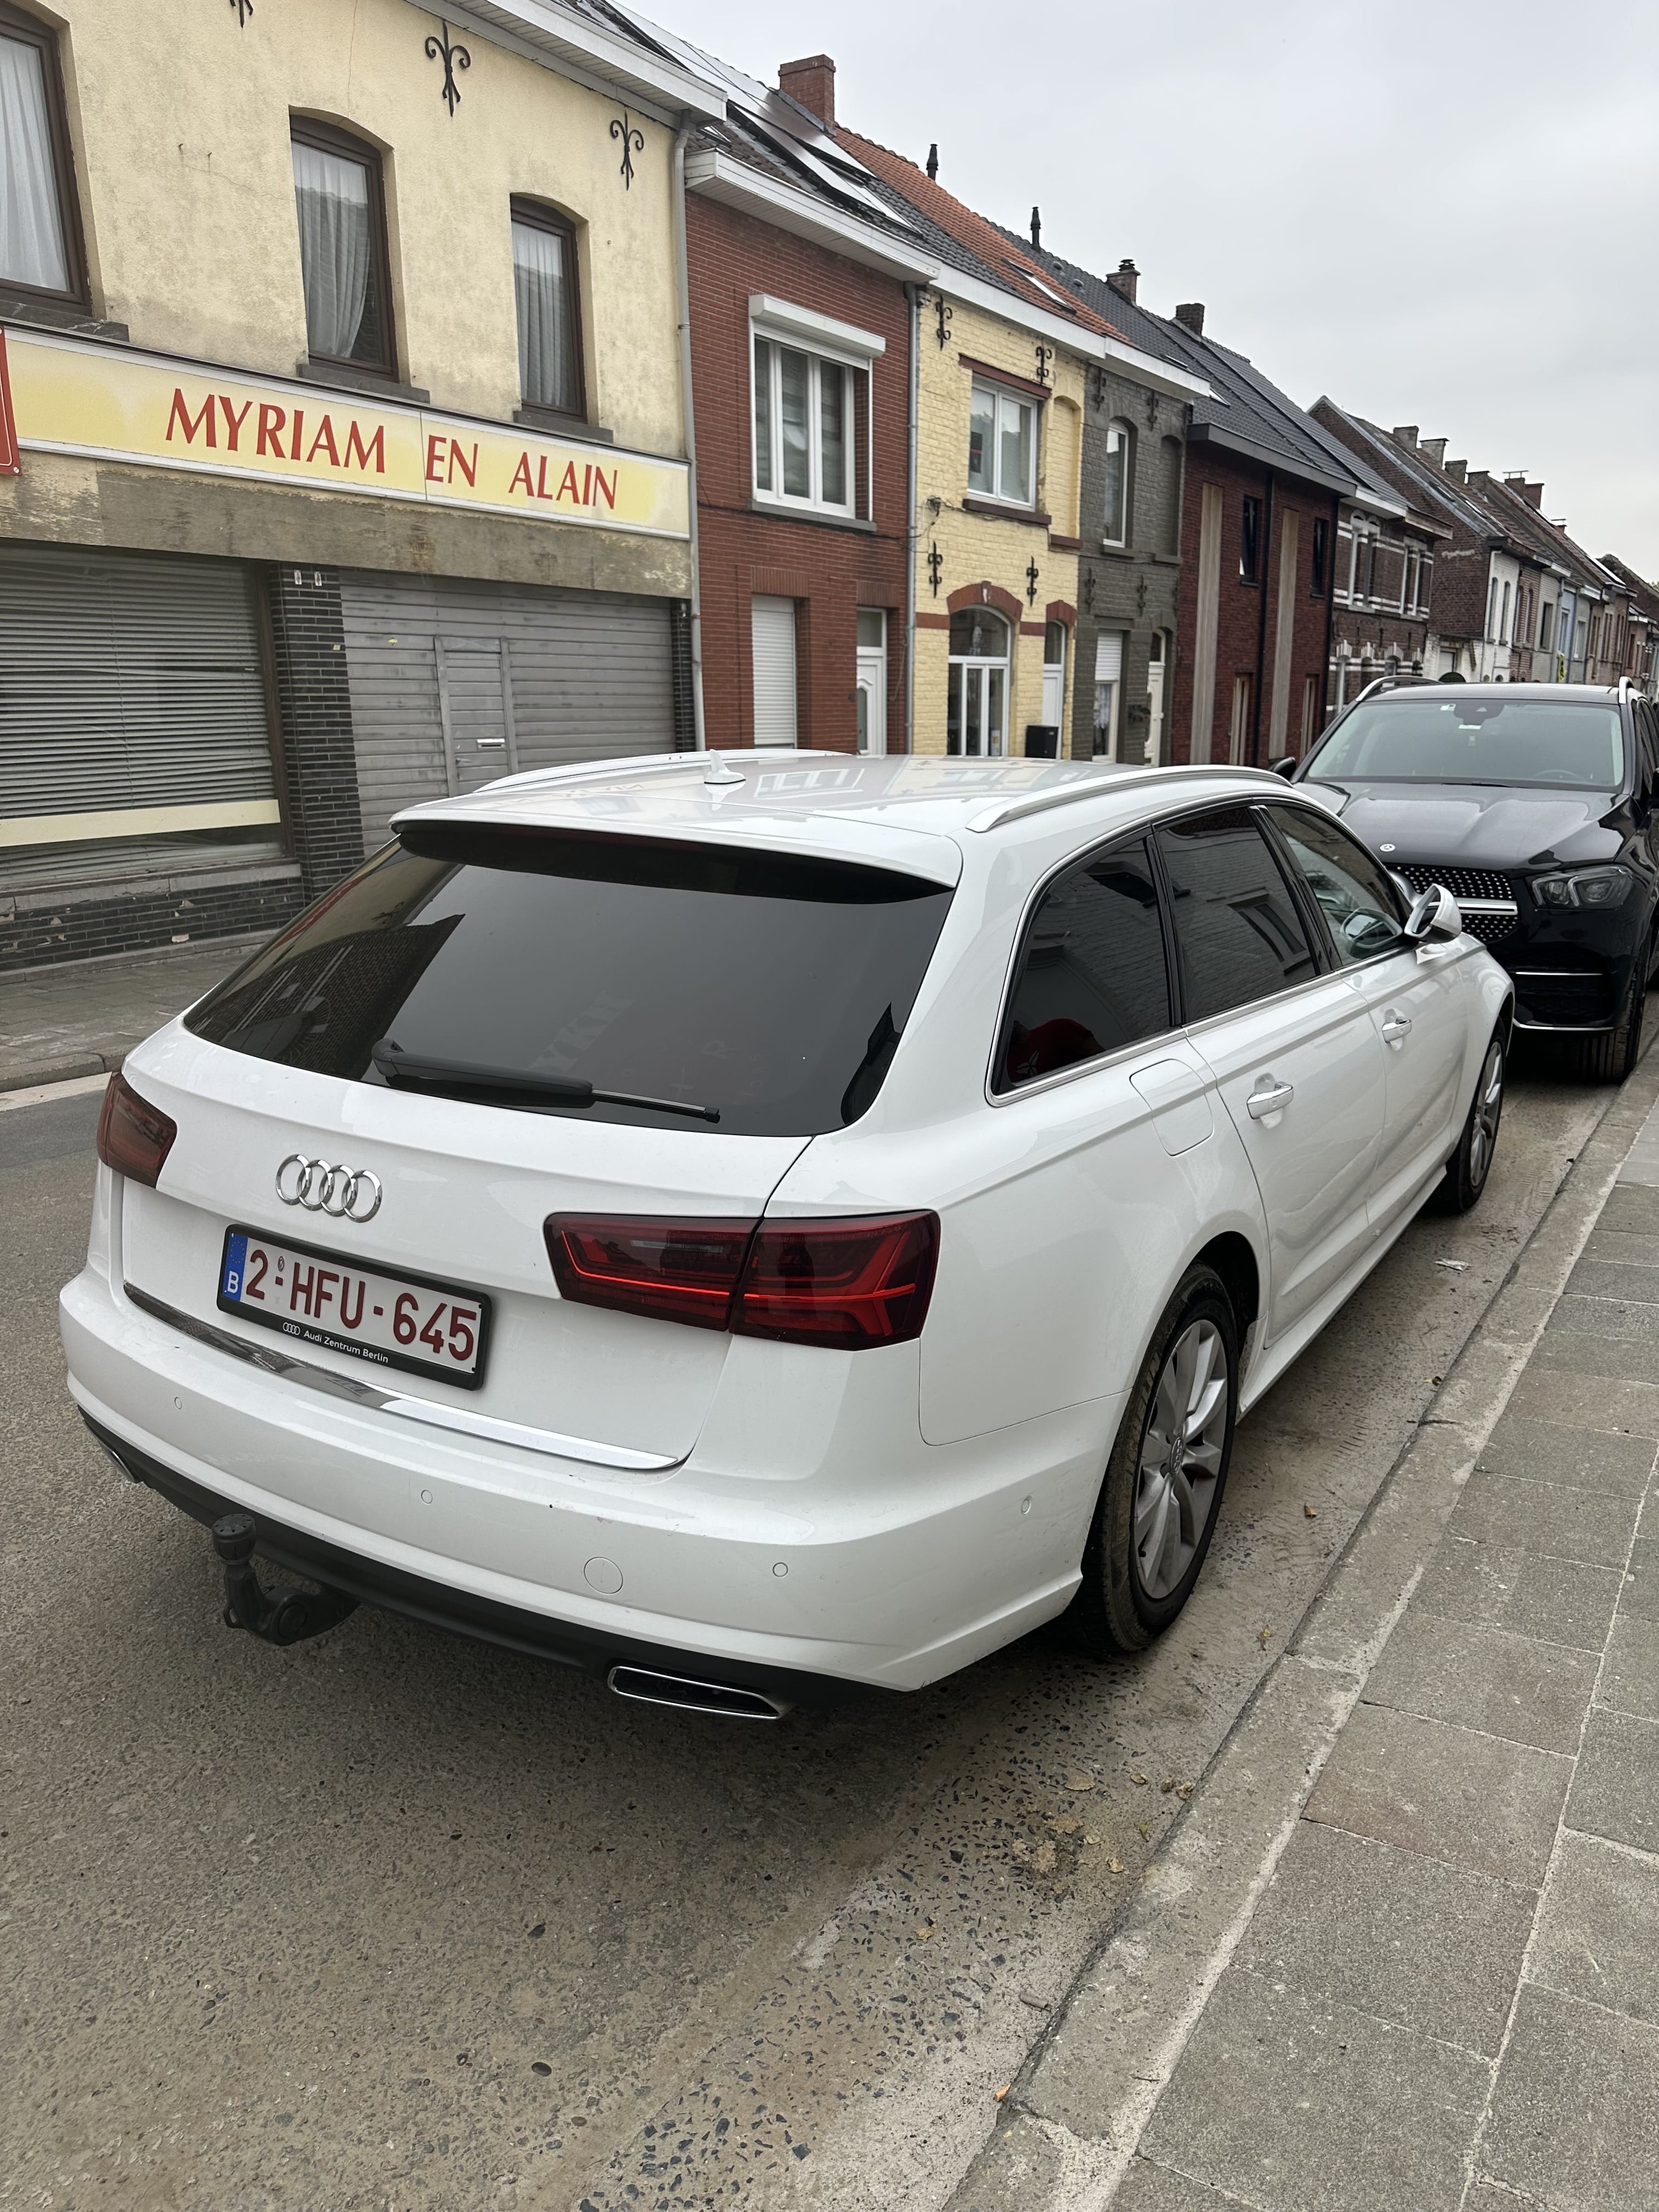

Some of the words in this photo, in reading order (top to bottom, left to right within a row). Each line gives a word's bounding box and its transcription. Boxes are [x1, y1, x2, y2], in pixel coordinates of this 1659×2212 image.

[165, 387, 385, 474] MYRIAM
[425, 434, 478, 488] EN
[508, 451, 618, 510] ALAIN
[227, 1270, 240, 1294] B
[245, 1249, 477, 1361] 2-HFU-645
[303, 1330, 323, 1343] Audi
[324, 1336, 360, 1355] Zentrum
[362, 1348, 389, 1364] Berlin
